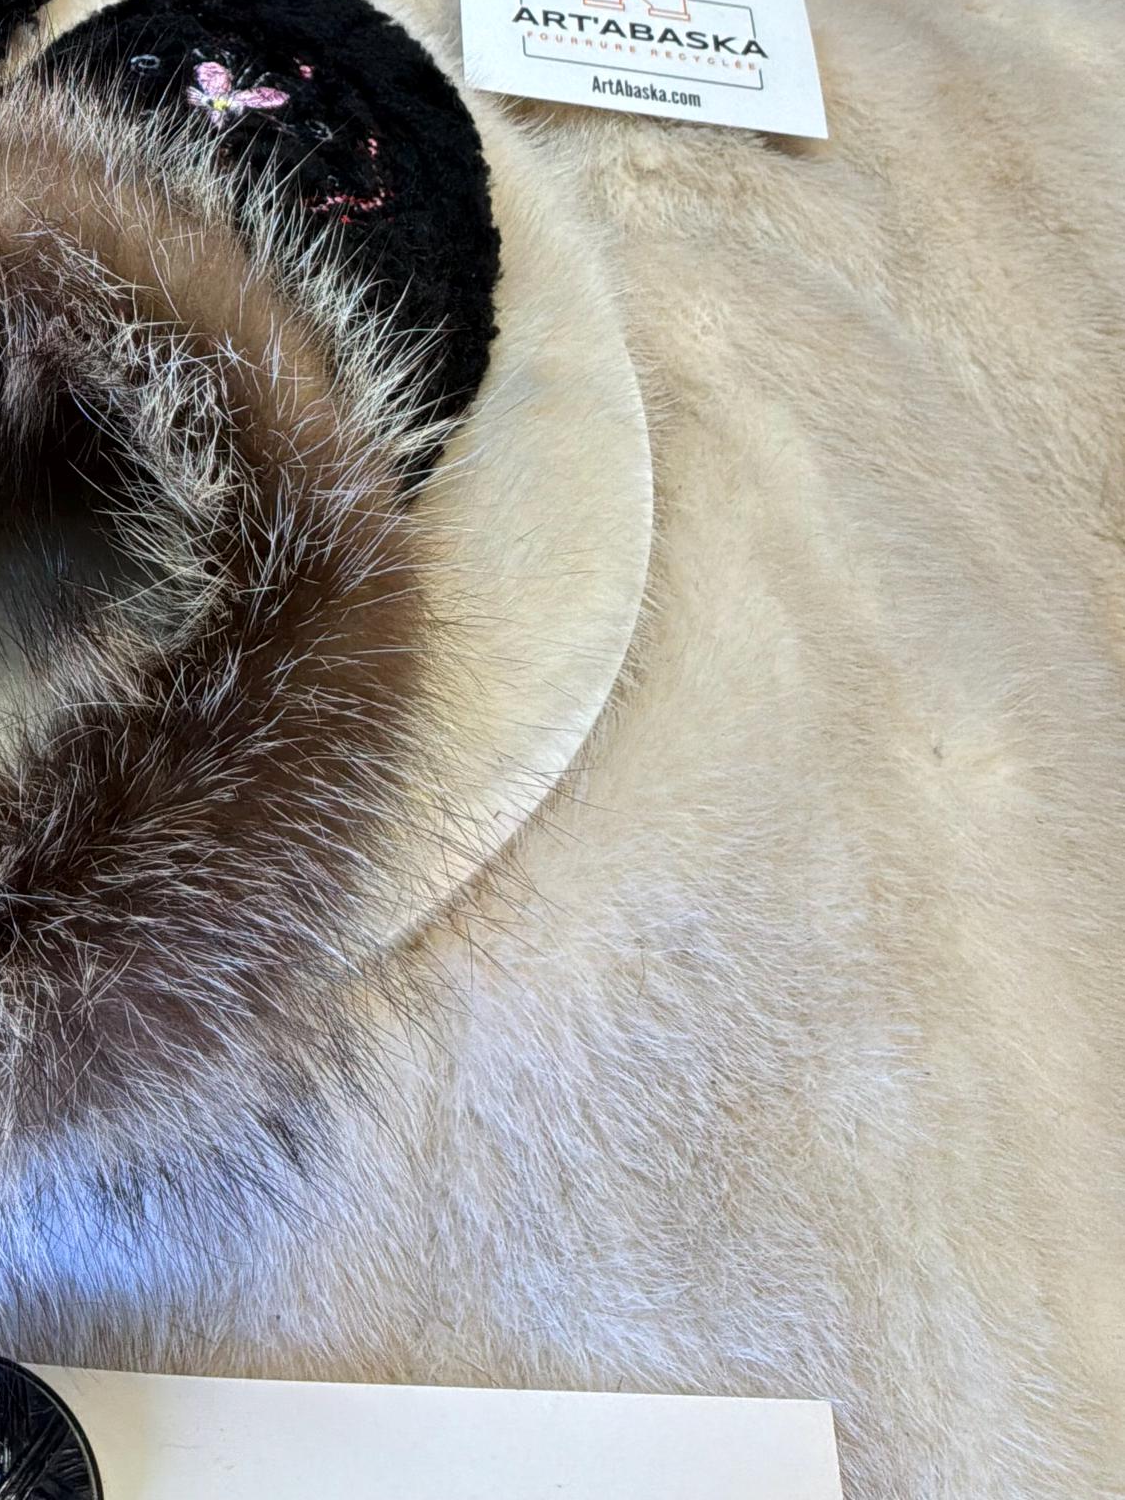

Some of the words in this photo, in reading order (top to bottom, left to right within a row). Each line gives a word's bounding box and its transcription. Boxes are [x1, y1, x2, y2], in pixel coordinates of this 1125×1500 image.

[512, 7, 769, 58] ART'ABASKA
[526, 30, 637, 54] FOURRURE
[592, 75, 701, 108] ArtAbaska.com
